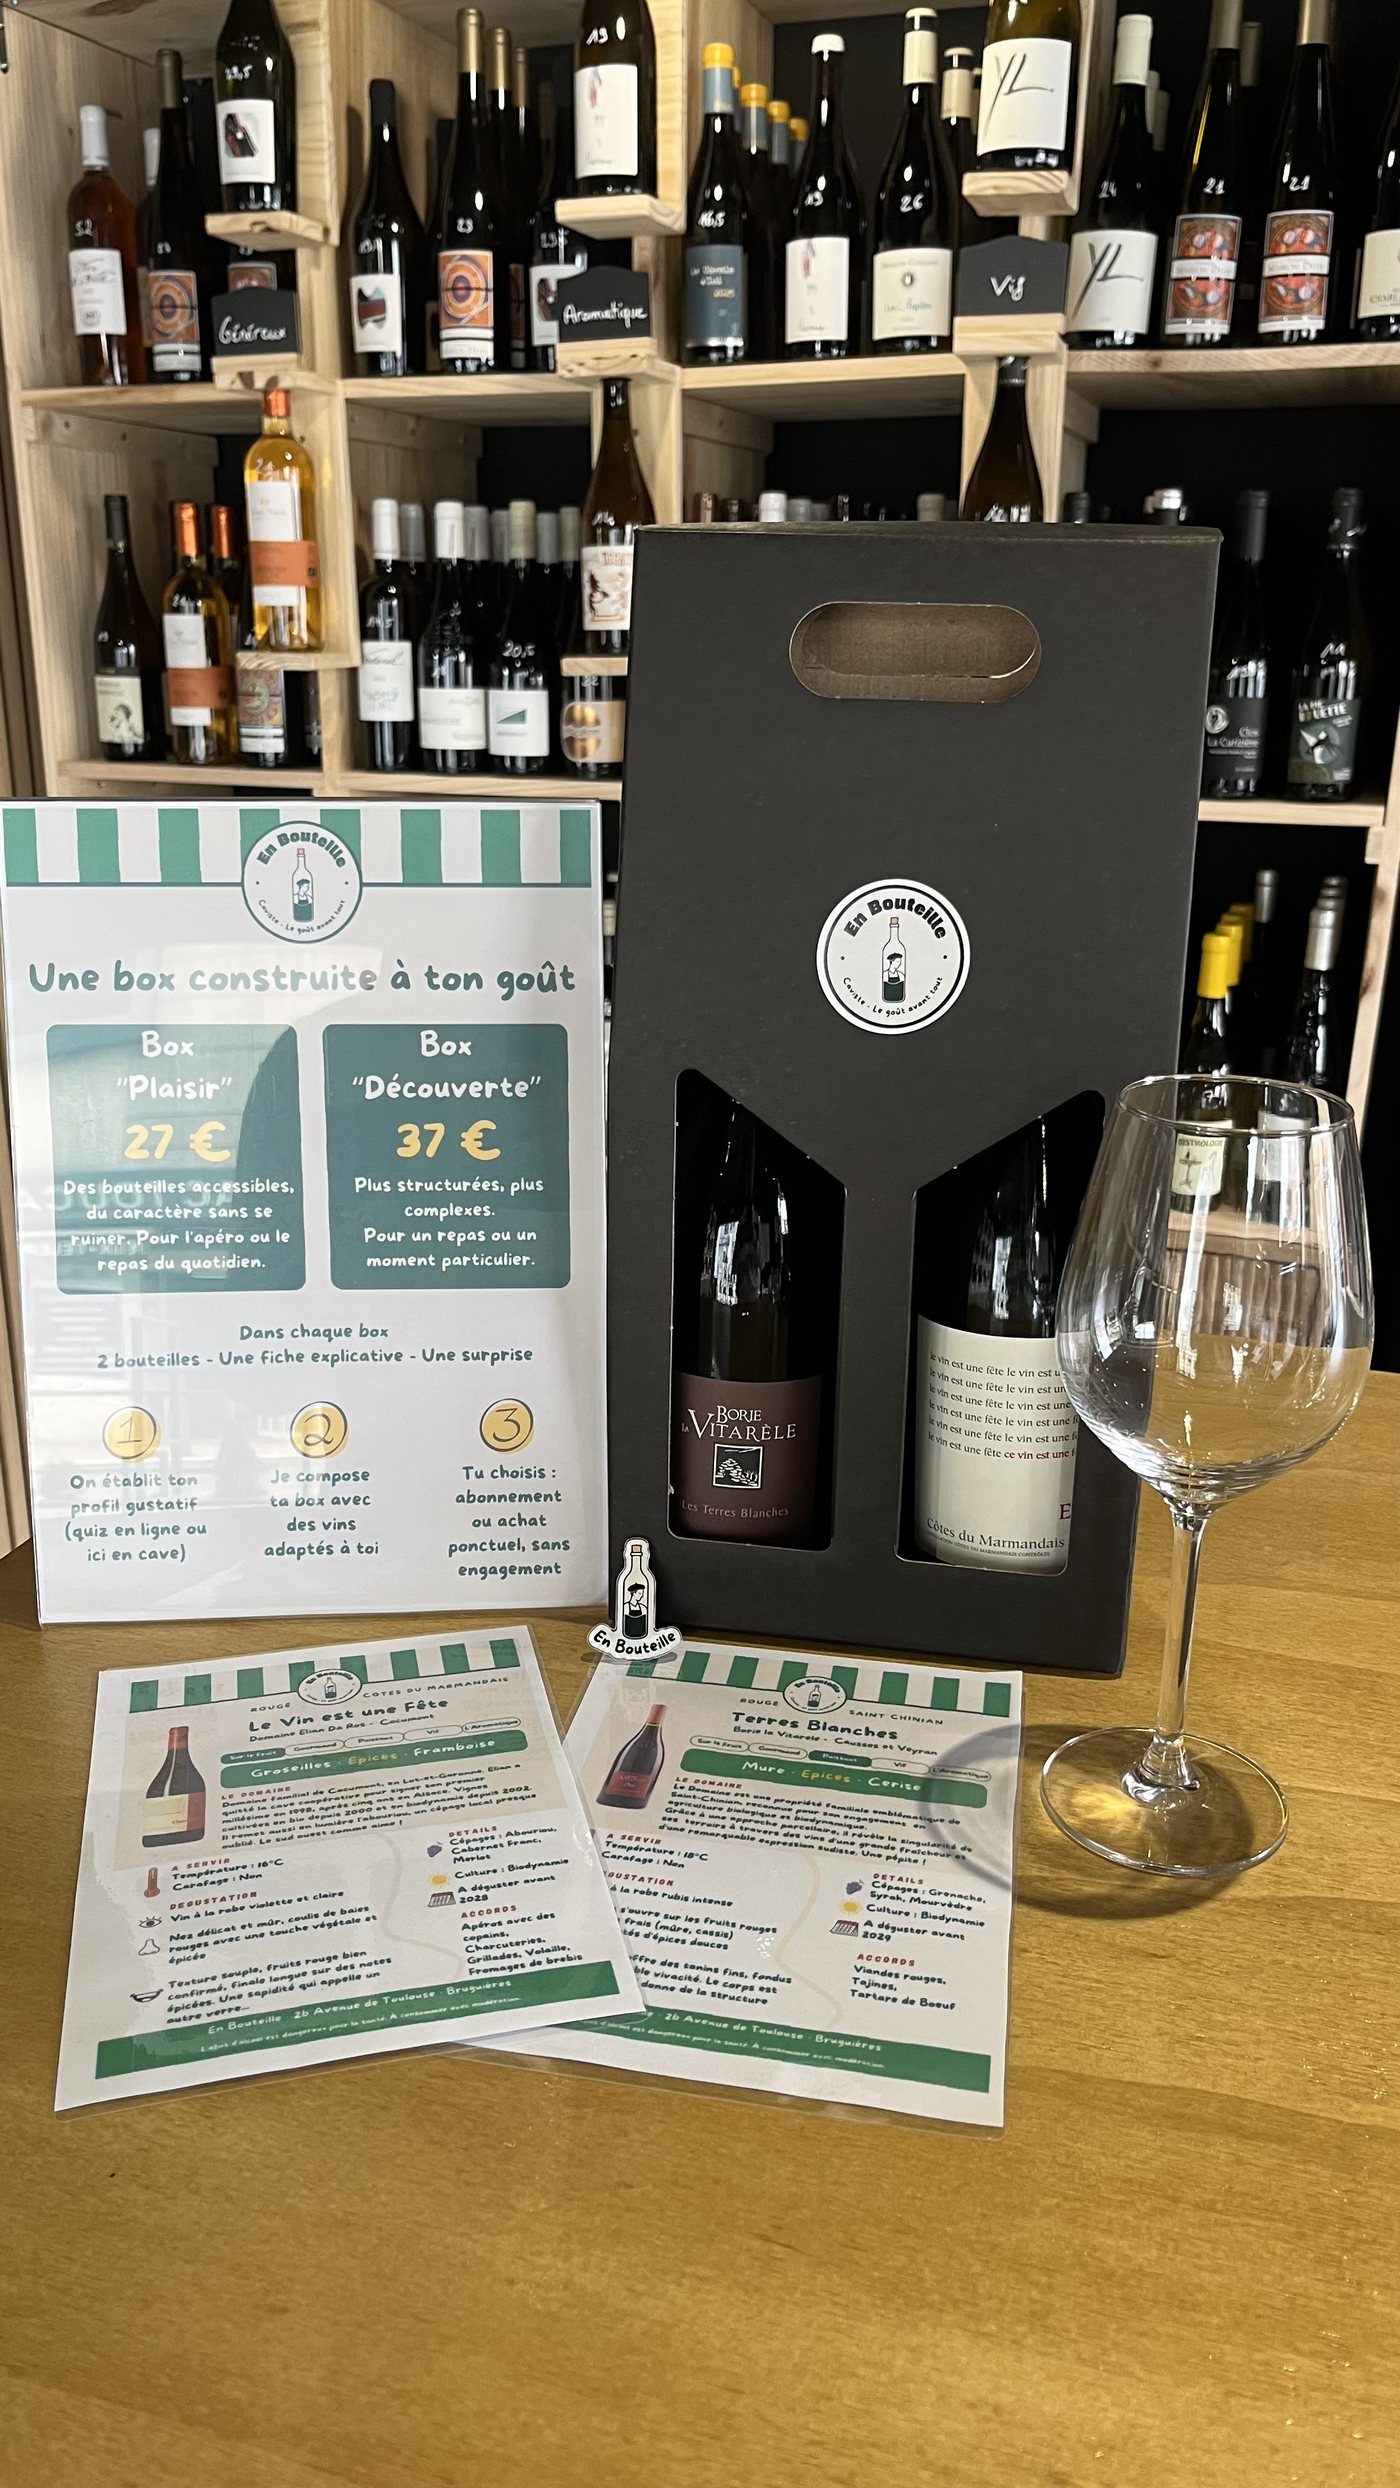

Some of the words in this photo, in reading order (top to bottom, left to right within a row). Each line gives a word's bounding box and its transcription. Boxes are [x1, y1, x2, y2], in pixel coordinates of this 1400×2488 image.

[1204, 177, 1225, 195] 21
[1289, 175, 1310, 191] 21
[900, 194, 924, 213] 26
[457, 218, 473, 234] 23
[990, 274, 1026, 301] Vif
[563, 302, 648, 329] Aromatique
[502, 639, 535, 658] 20,5
[257, 844, 277, 865] En
[277, 832, 346, 867] Bouteille
[259, 900, 279, 923] Caviste
[285, 923, 294, 931] Le
[297, 925, 314, 934] goût
[317, 916, 335, 930] avant
[335, 900, 345, 915] tout
[844, 912, 868, 937] En
[867, 898, 946, 939] Bouteille
[29, 963, 99, 992] Une
[114, 960, 174, 992] box
[189, 962, 377, 993] construite
[390, 960, 412, 990] à
[425, 965, 483, 992] ton
[497, 962, 576, 1001] goût
[843, 977, 865, 1006] Caviste
[873, 1005, 882, 1013] Le
[886, 1007, 905, 1017] goût
[908, 994, 931, 1011] avant
[930, 977, 942, 994] tout
[141, 1031, 194, 1057] Box
[420, 1030, 471, 1056] Box
[124, 1125, 173, 1160] 27
[189, 1121, 231, 1162] €
[397, 1123, 445, 1158] 37
[460, 1120, 500, 1160] €
[63, 1180, 96, 1195] Des
[102, 1179, 186, 1194] bouteilles
[192, 1179, 295, 1194] accessibles,
[355, 1177, 391, 1193] Plus
[397, 1176, 505, 1195] structurées,
[510, 1177, 544, 1197] plus
[86, 1205, 108, 1220] du
[114, 1204, 202, 1220] caractère
[208, 1206, 248, 1218] sans
[254, 1206, 273, 1218] se
[404, 1202, 496, 1222] complexes.
[71, 1231, 131, 1247] ruiner.
[136, 1230, 179, 1244] Pour
[185, 1229, 244, 1249] l'apéro
[250, 1232, 270, 1244] ou
[276, 1230, 290, 1243] le
[364, 1228, 405, 1244] Pour
[411, 1230, 433, 1243] un
[437, 1230, 486, 1248] repas
[492, 1230, 512, 1243] ou
[517, 1230, 537, 1243] un
[98, 1257, 148, 1276] repas
[154, 1255, 174, 1270] du
[181, 1254, 266, 1277] quotidien.
[366, 1252, 436, 1268] moment
[441, 1252, 536, 1271] particulier.
[240, 1325, 284, 1341] Dans
[290, 1324, 353, 1344] chaque
[359, 1323, 389, 1340] box
[97, 1354, 108, 1370] 2
[114, 1351, 200, 1369] bouteilles
[218, 1351, 255, 1366] Une
[260, 1349, 305, 1364] fiche
[310, 1348, 403, 1368] explicative
[421, 1348, 456, 1363] Une
[462, 1347, 533, 1367] surprise
[118, 1417, 143, 1445] 1
[304, 1413, 334, 1446] 2
[493, 1408, 523, 1443] 3
[928, 1432, 934, 1442] le
[936, 1435, 947, 1446] vin
[950, 1441, 962, 1451] est
[964, 1445, 981, 1455] une
[984, 1447, 1002, 1458] fête
[1018, 1451, 1033, 1460] vin
[1035, 1451, 1050, 1459] est
[1052, 1451, 1070, 1459] une
[70, 1475, 97, 1490] On
[102, 1472, 163, 1489] établit
[168, 1474, 199, 1487] ton
[270, 1469, 290, 1485] Je
[295, 1468, 371, 1487] compose
[462, 1466, 488, 1481] Tu
[491, 1465, 546, 1480] choisis
[71, 1497, 121, 1518] profil
[126, 1496, 199, 1516] gustatif
[269, 1494, 290, 1508] ta
[295, 1493, 326, 1507] box
[331, 1494, 372, 1507] avec
[455, 1489, 562, 1505] abonnement
[682, 1500, 698, 1512] Les
[703, 1504, 735, 1517] Terres
[741, 1507, 789, 1518] Blanches
[286, 1517, 317, 1533] des
[323, 1517, 357, 1531] vins
[472, 1515, 492, 1528] ou
[497, 1513, 547, 1528] achat
[64, 1521, 109, 1542] (quiz
[114, 1525, 135, 1537] en
[140, 1522, 182, 1541] ligne
[186, 1523, 208, 1536] ou
[927, 1517, 955, 1538] Côtes
[959, 1529, 975, 1543] du
[979, 1534, 1065, 1549] Marmandais
[87, 1548, 107, 1562] ici
[112, 1550, 133, 1562] en
[138, 1543, 187, 1564] cave)
[264, 1541, 336, 1560] adaptés
[340, 1540, 352, 1555] à
[357, 1542, 380, 1555] toi
[448, 1538, 527, 1558] ponctuel,
[531, 1539, 571, 1553] sans
[457, 1562, 562, 1579] engagement
[594, 1630, 610, 1648] En
[615, 1632, 676, 1654] Bouteille
[407, 1686, 422, 1694] DU
[428, 1677, 509, 1691] MARMANDAIS
[249, 1720, 271, 1732] Le
[280, 1714, 314, 1728] Vin
[322, 1710, 353, 1722] est
[362, 1704, 397, 1717] une
[404, 1698, 449, 1714] Fête
[849, 1709, 885, 1719] SAINT
[891, 1714, 944, 1725] CHINIAN
[731, 1712, 799, 1729] Terres
[807, 1719, 898, 1740] Blanches
[251, 1760, 332, 1778] Groseilles
[414, 1739, 496, 1757] Framboise
[742, 1761, 785, 1775] Mure
[801, 1769, 851, 1783] Epices
[868, 1777, 921, 1792] Cerise
[461, 1904, 518, 1919] ACCORDS
[461, 1919, 503, 1932] Apéros
[506, 1916, 534, 1926] avec
[536, 1912, 556, 1921] des
[857, 1953, 916, 1967] ACCORDS
[852, 1977, 897, 1992] Tajines,
[854, 1965, 900, 1979] Viandes
[904, 1972, 946, 1985] rouges,
[850, 1989, 898, 2003] Tartare
[902, 1997, 916, 2006] de
[919, 1998, 956, 2011] Boeuf
